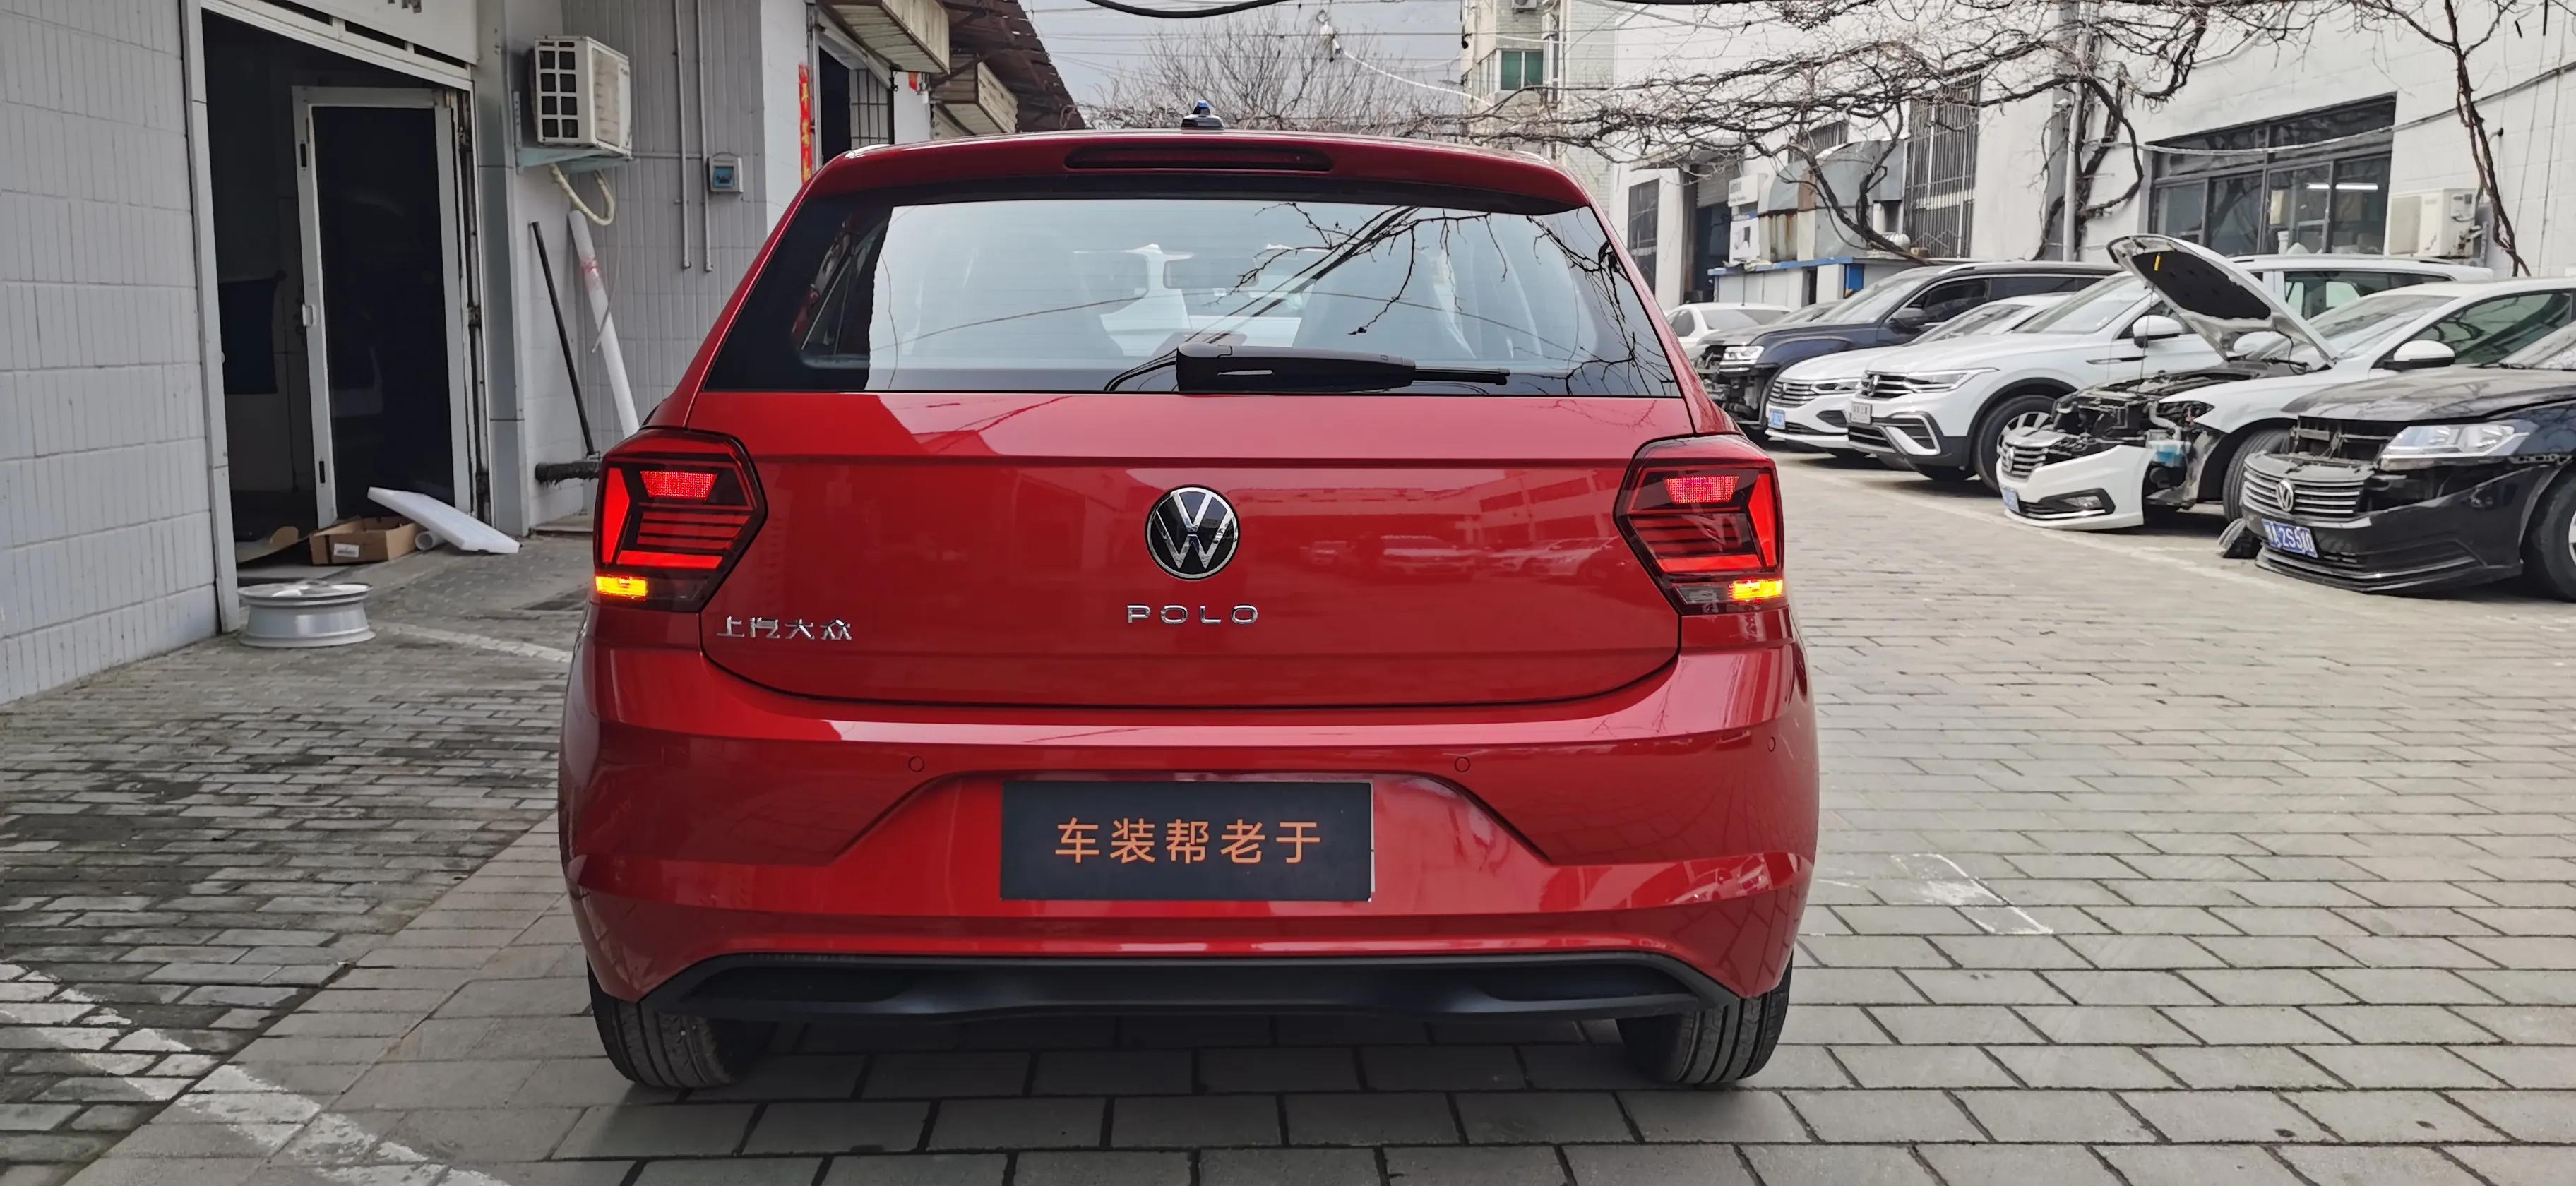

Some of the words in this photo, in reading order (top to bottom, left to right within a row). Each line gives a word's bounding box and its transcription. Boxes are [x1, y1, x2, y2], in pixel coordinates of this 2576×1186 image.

[1127, 605, 1258, 624] POLO
[716, 616, 852, 640] 上汽大众
[1055, 817, 1320, 864] 车装帮老于
